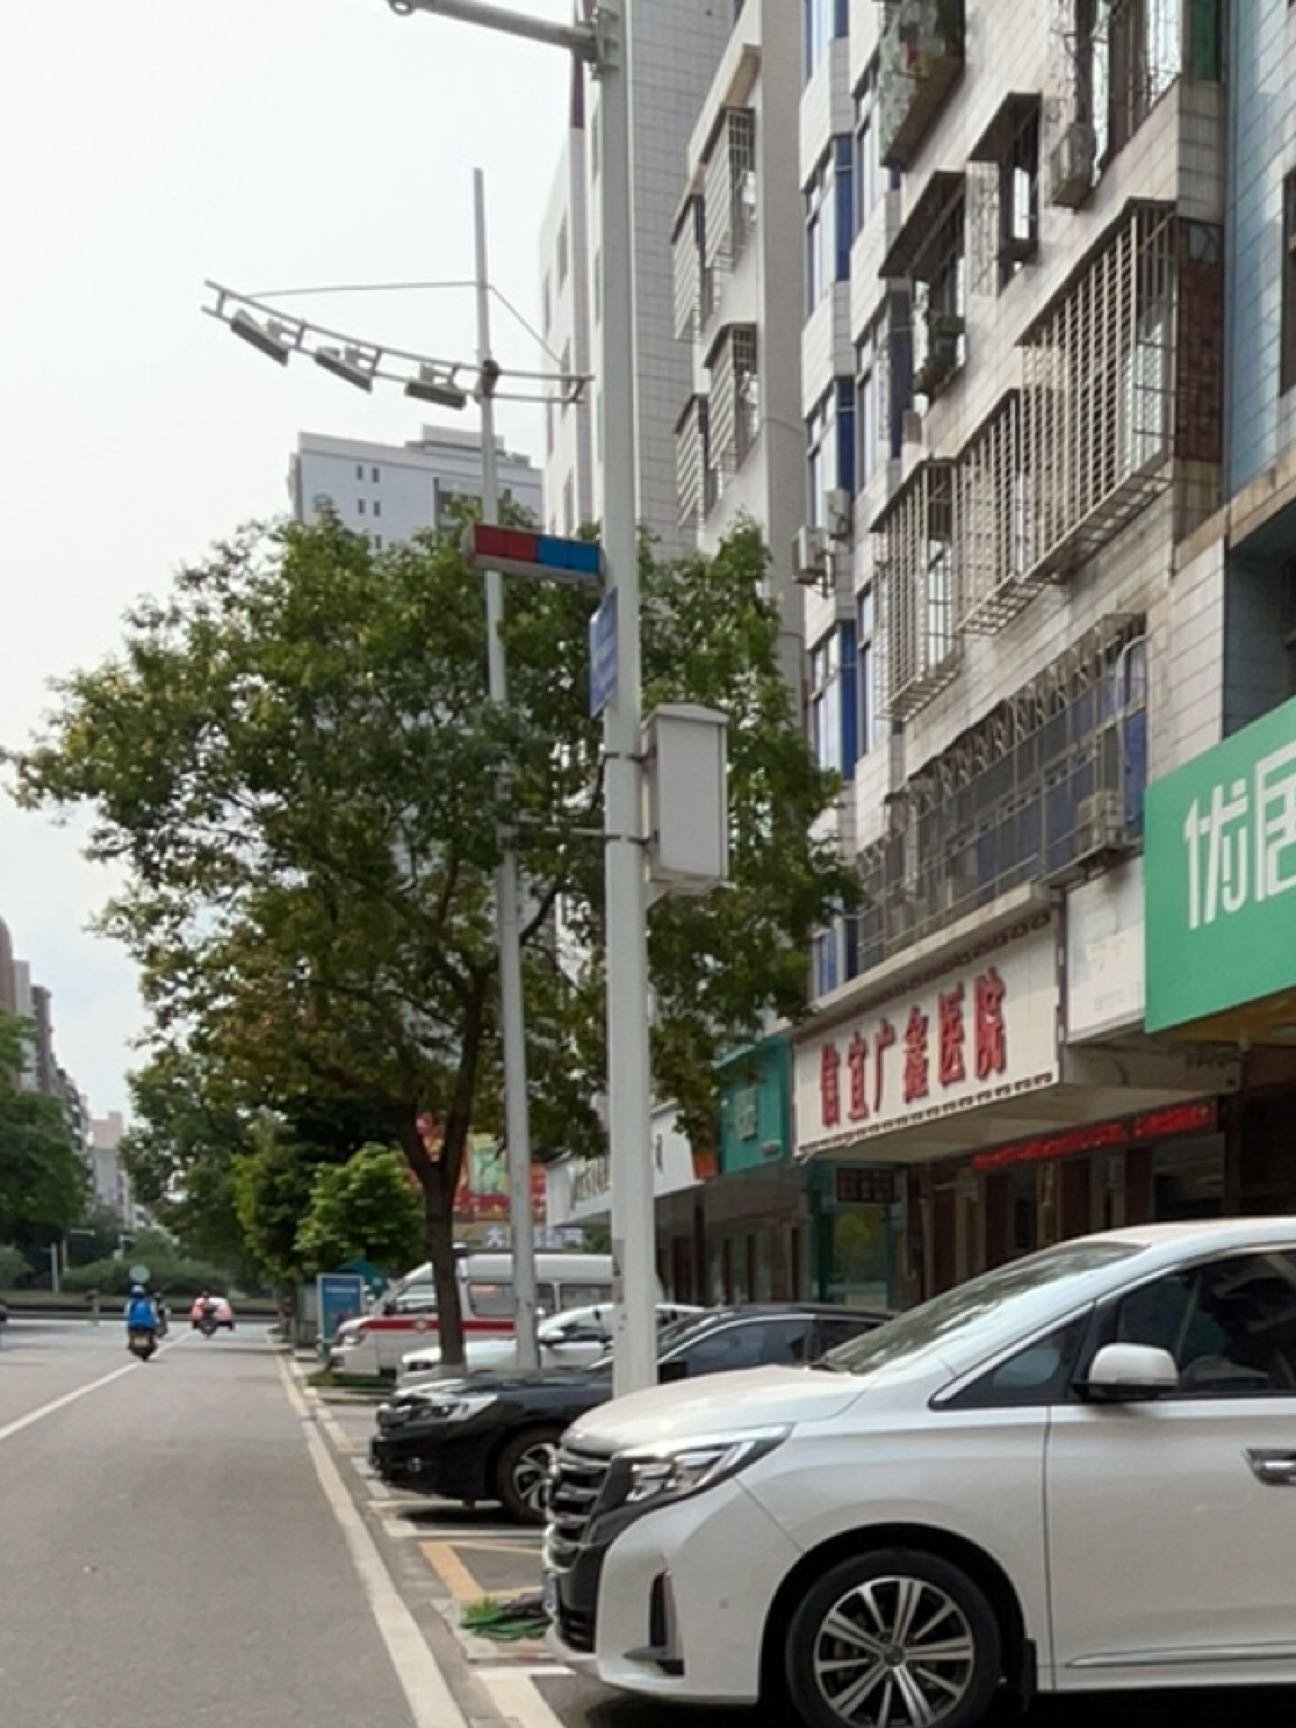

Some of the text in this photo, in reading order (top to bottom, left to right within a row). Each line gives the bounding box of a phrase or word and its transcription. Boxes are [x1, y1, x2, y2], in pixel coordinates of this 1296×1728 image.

[820, 966, 1007, 1128] 信宜广鑫医院
